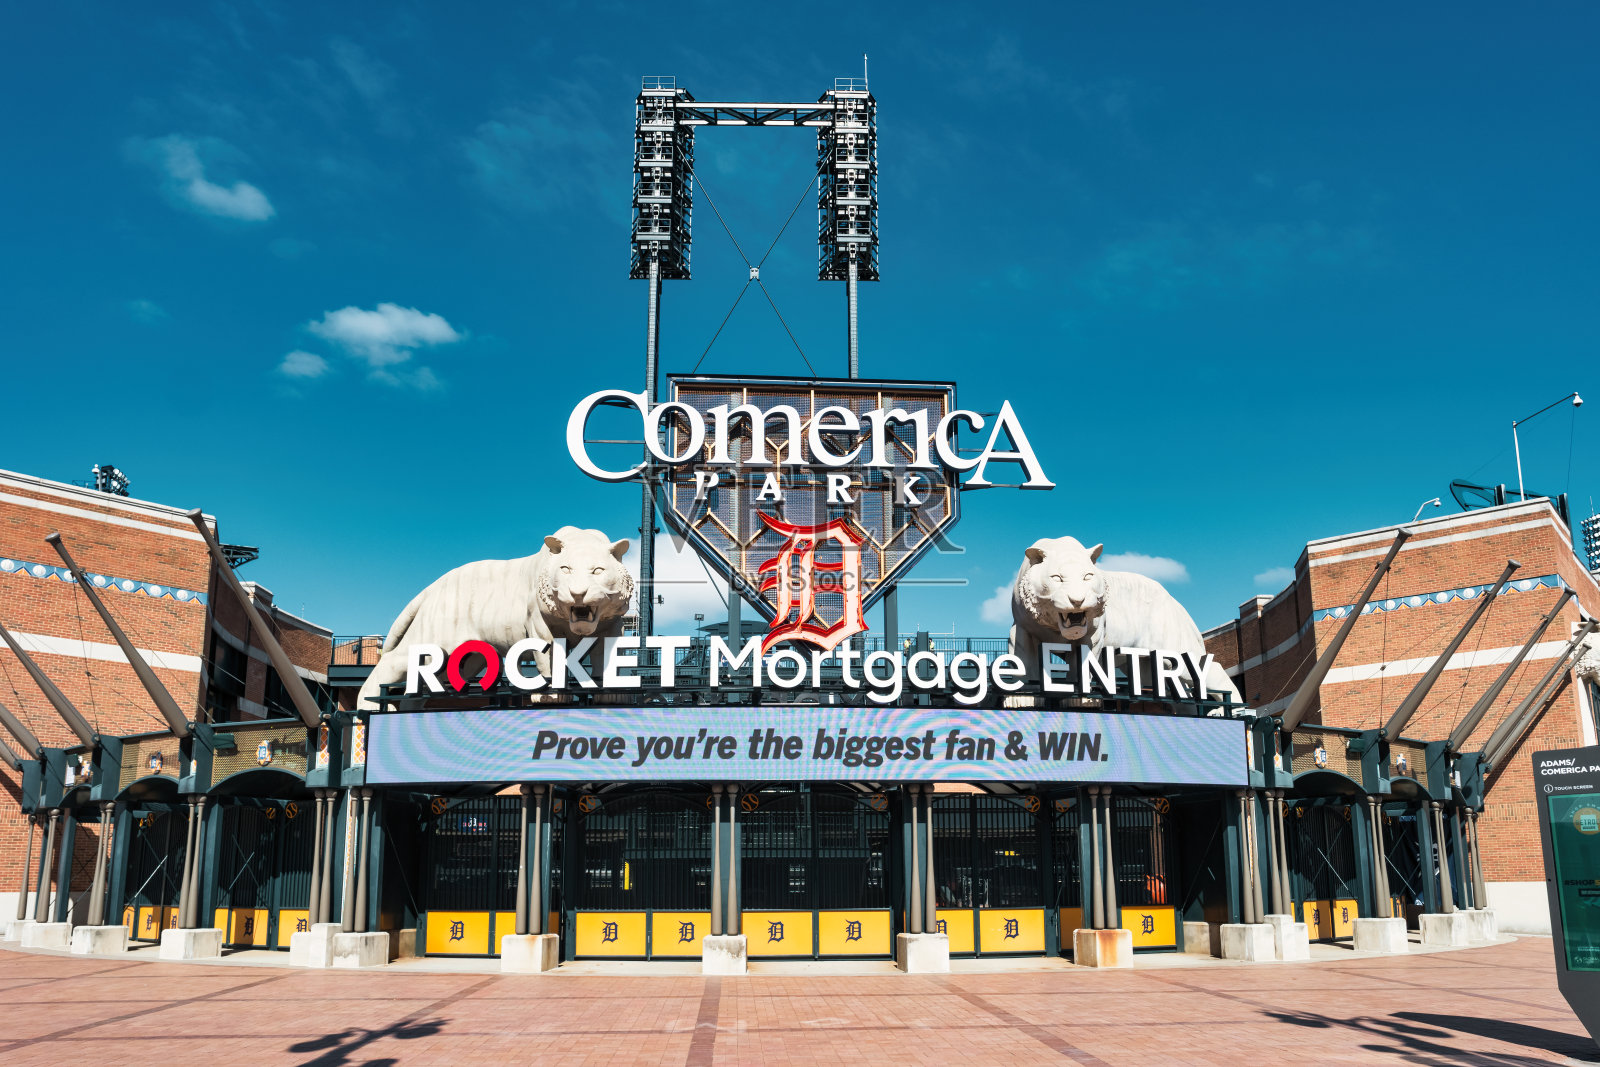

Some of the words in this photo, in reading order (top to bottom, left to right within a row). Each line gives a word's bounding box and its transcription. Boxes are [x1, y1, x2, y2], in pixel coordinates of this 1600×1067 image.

[693, 471, 923, 507] PARK
[405, 636, 691, 694] ROCKET
[709, 635, 1026, 704] Mortgage
[1038, 642, 1215, 700] ENTRY
[531, 729, 626, 760] Prove
[631, 728, 737, 767] you're
[748, 728, 803, 760] the
[812, 728, 936, 767] biggest
[945, 729, 996, 761] fan
[1004, 730, 1028, 761] &
[1037, 731, 1109, 762] WIN.
[1540, 758, 1576, 767] ADAMS/
[1541, 765, 1588, 775] COMERICA
